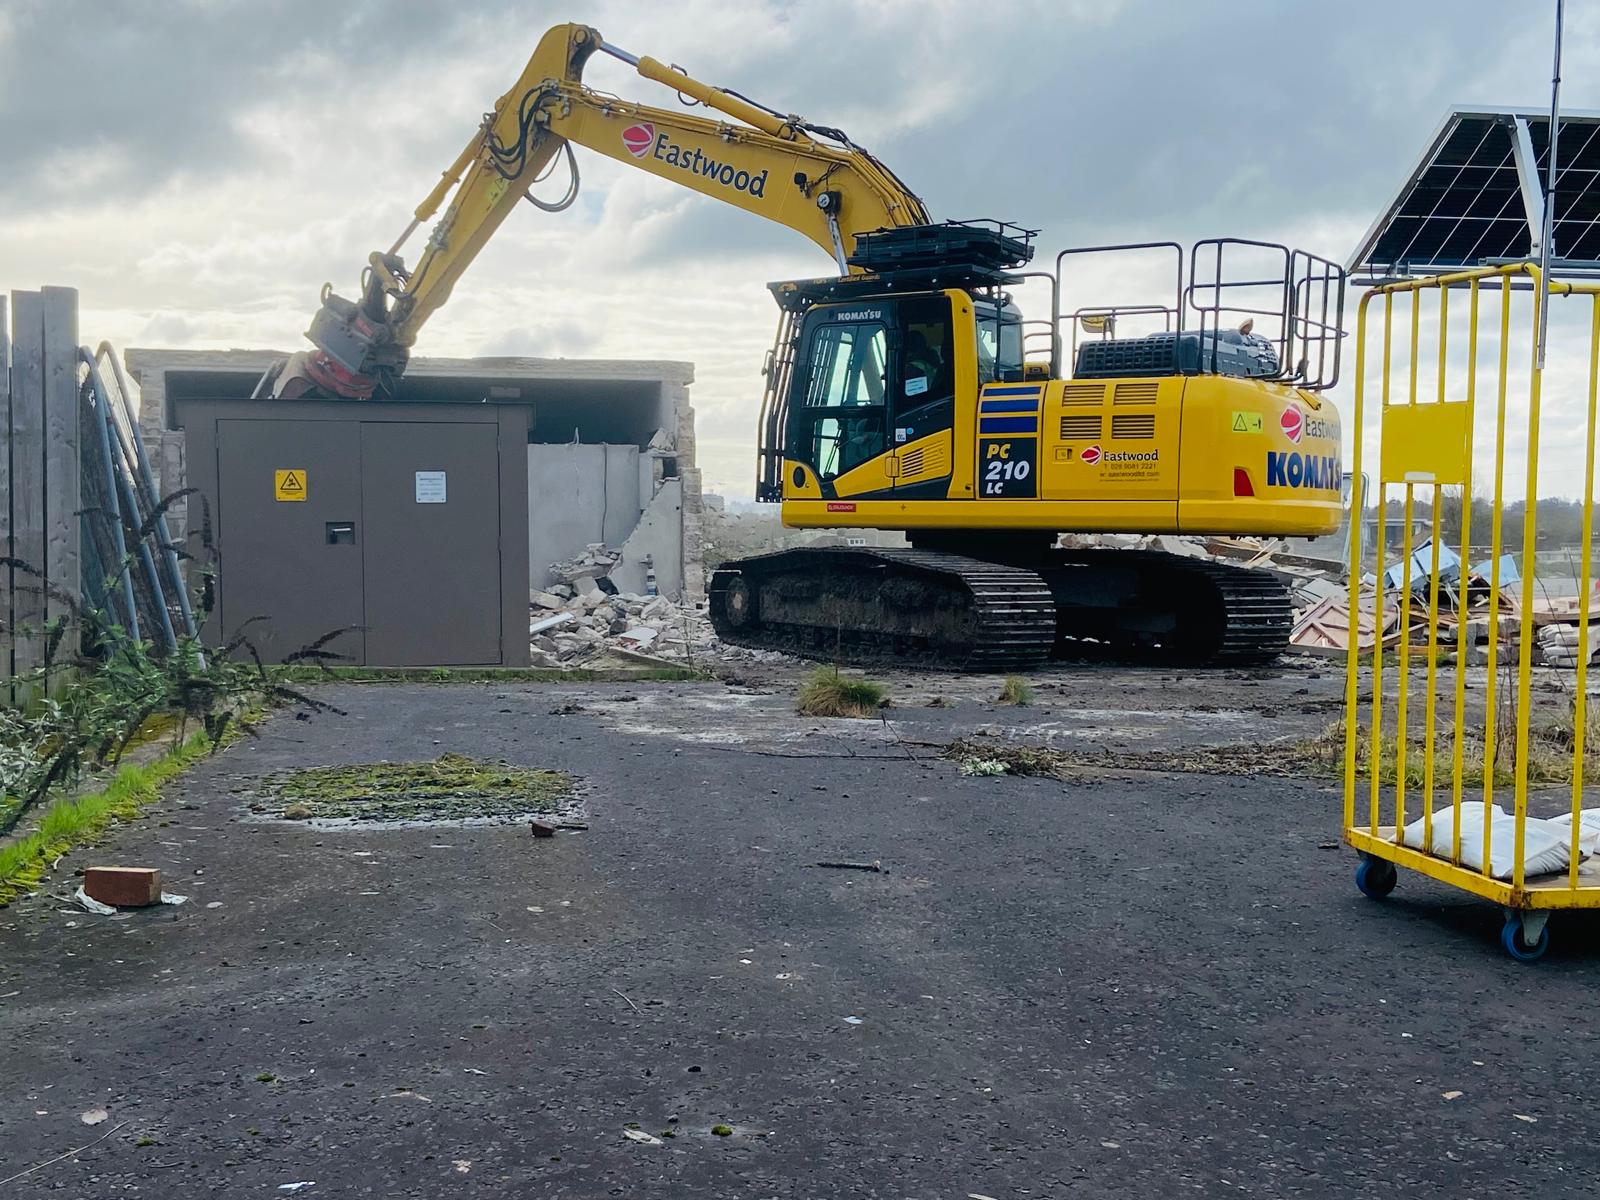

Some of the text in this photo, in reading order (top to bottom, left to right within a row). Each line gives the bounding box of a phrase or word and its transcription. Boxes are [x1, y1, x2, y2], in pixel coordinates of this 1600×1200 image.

[653, 133, 768, 198] Eastwood
[837, 309, 882, 321] KOMATSU
[986, 443, 1011, 459] PC
[1103, 448, 1159, 461] Eastwood
[985, 460, 1030, 480] 210
[1267, 448, 1341, 491] KOMATS
[986, 482, 1004, 494] LC
